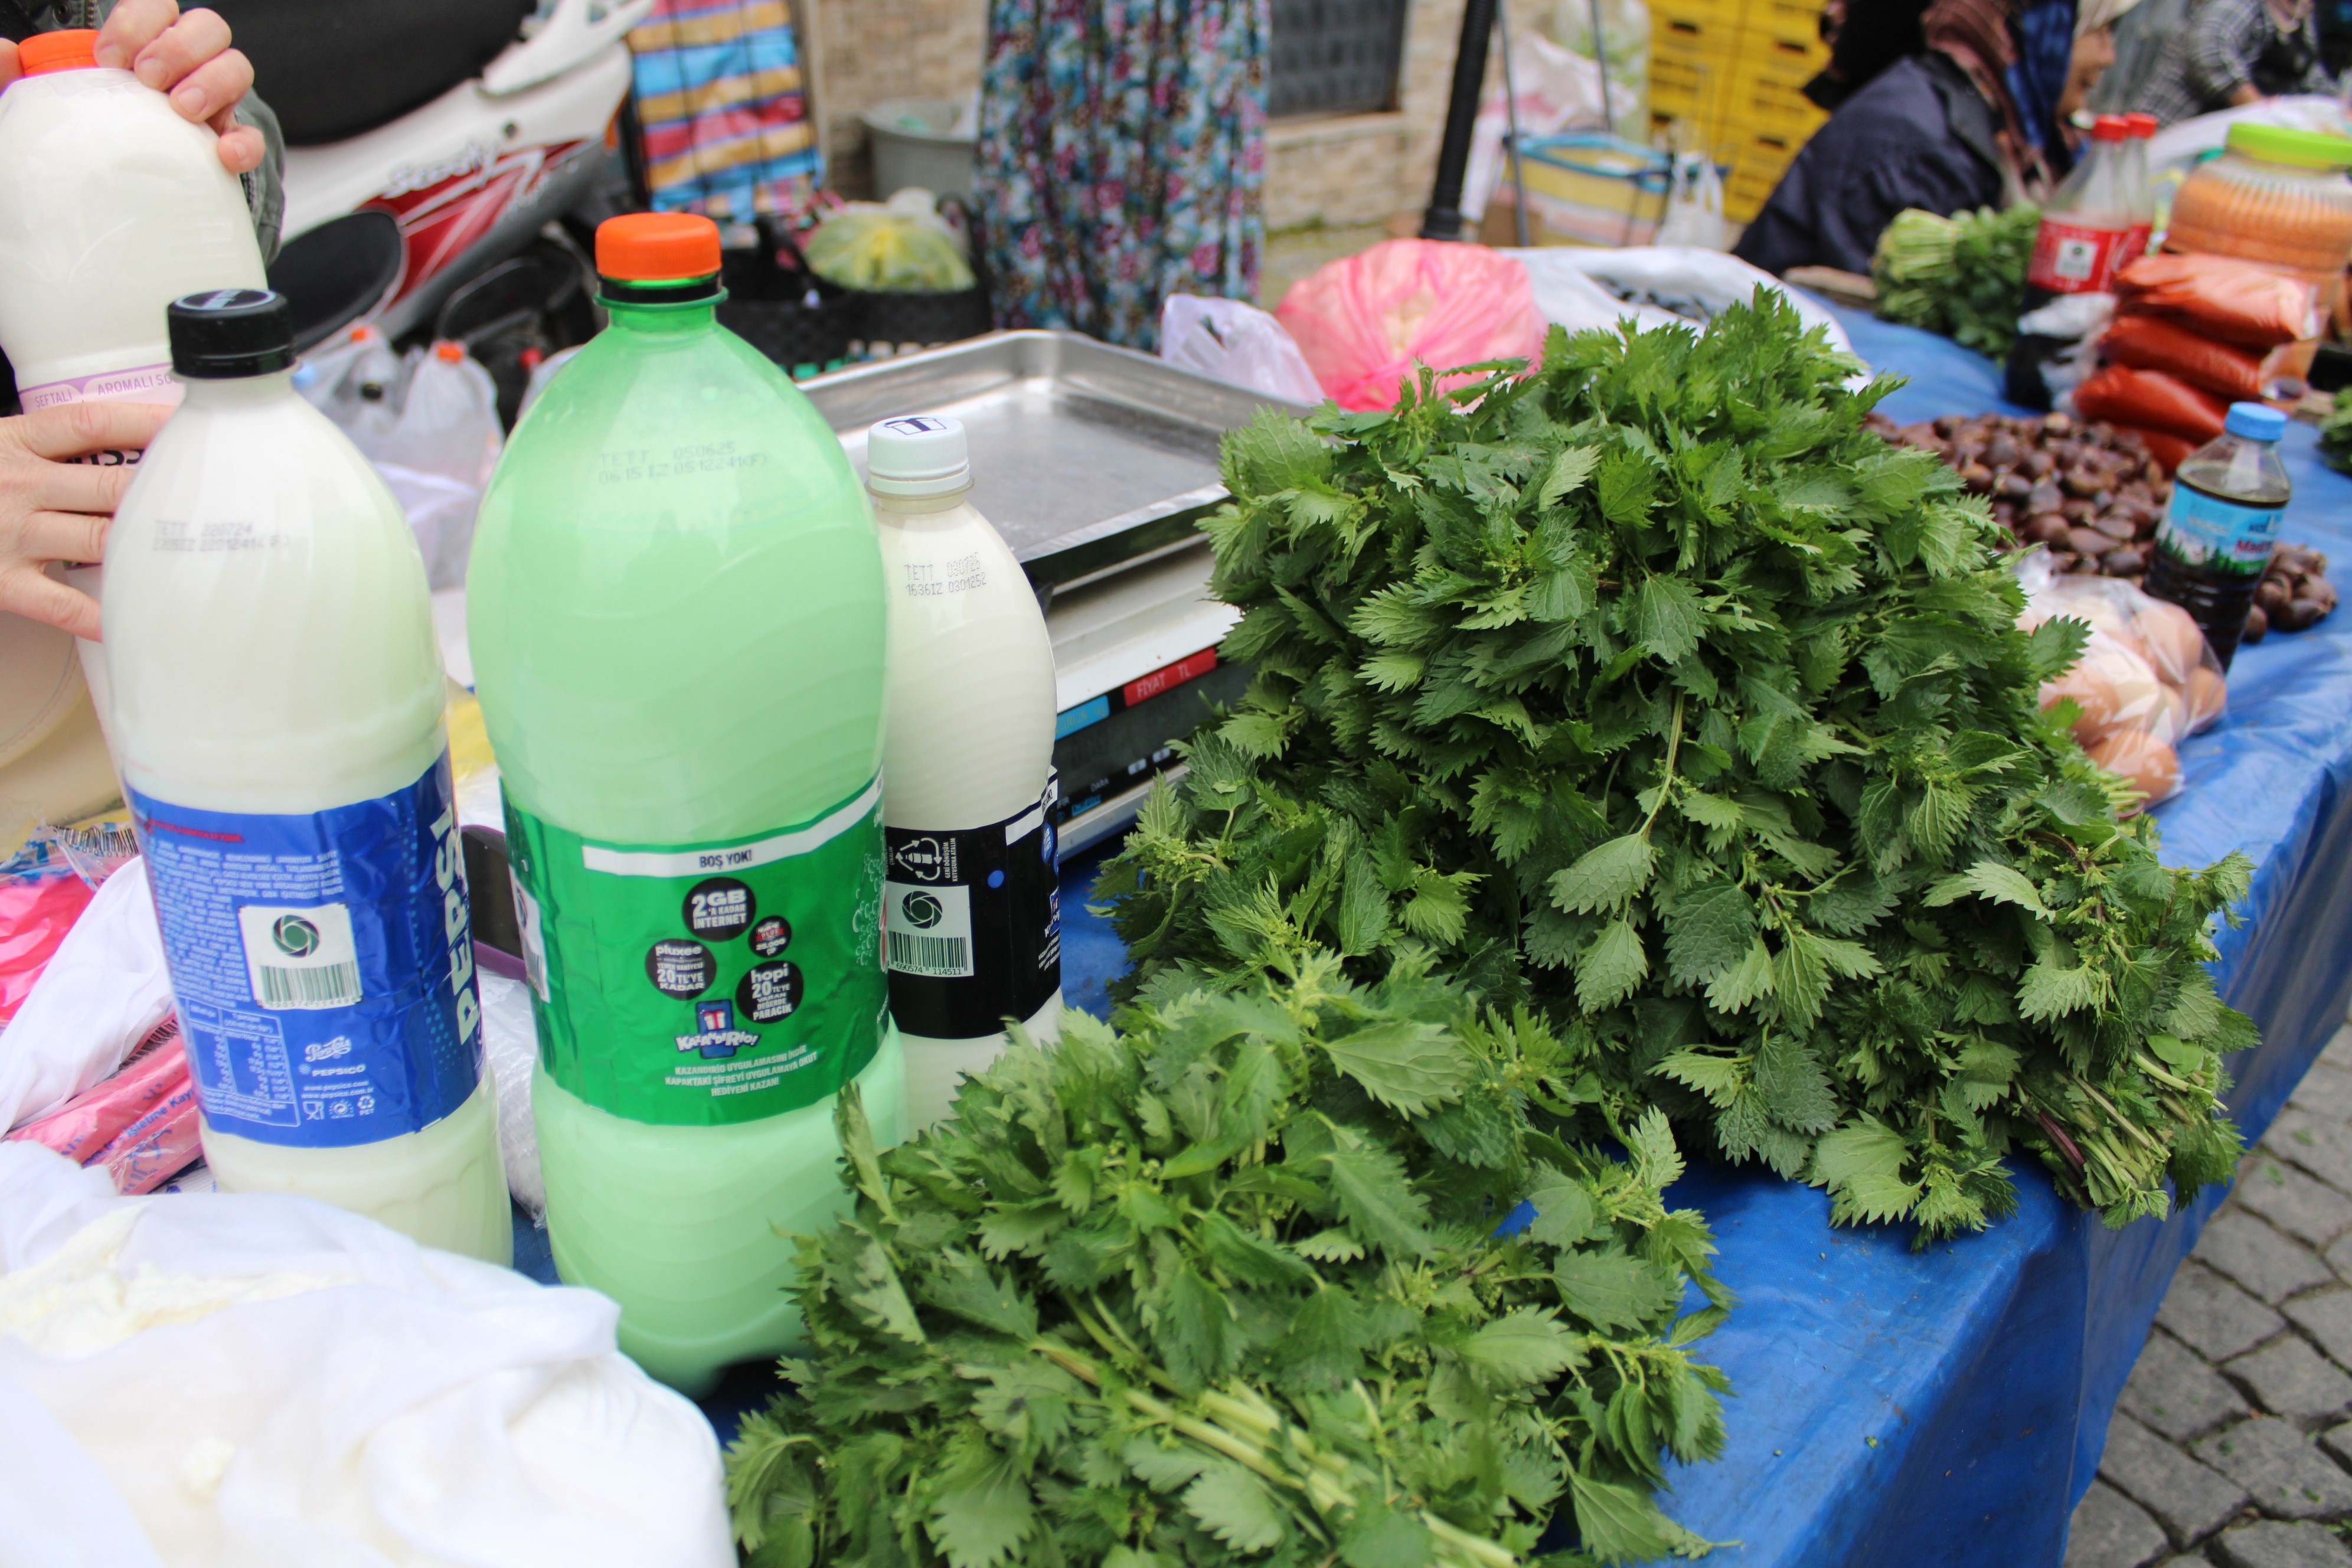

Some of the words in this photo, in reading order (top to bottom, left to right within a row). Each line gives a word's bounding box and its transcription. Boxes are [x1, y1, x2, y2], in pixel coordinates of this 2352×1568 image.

[97, 376, 154, 397] AROMALI
[35, 390, 73, 410] ŞEFTALİ
[903, 564, 933, 580] TETT
[1177, 664, 1191, 678] TL
[699, 855, 723, 870] BOŞ
[726, 849, 752, 865] YOK!
[942, 841, 950, 866] DÖNÜŞÜM
[718, 904, 746, 915] KADAR
[655, 944, 703, 956] pluxee
[751, 962, 788, 984] hopi
[896, 962, 923, 974] 690574
[657, 969, 675, 984] 20
[677, 972, 704, 984] TL'YE
[659, 982, 704, 991] KADAR
[752, 981, 772, 999] 20
[772, 984, 790, 993] TL'YE
[753, 1004, 792, 1021] PARACIK
[312, 1063, 366, 1077] PEPSICO
[665, 1076, 711, 1086] KAPAKTAKİ
[713, 1072, 744, 1086] ŞİFREYİ
[746, 1061, 798, 1080] UYGULAMAYA
[799, 1051, 818, 1067] OKUT
[675, 1064, 726, 1075] KAZANDIRİO
[727, 1053, 787, 1072] UYGULAMASINI
[300, 1087, 374, 1099] www.pepsico.com.tr
[303, 1080, 370, 1091] www.pepsico.com
[711, 1085, 748, 1096] HEDİYENİ
[750, 1077, 779, 1092] KAZAN!
[359, 1108, 374, 1116] PET
